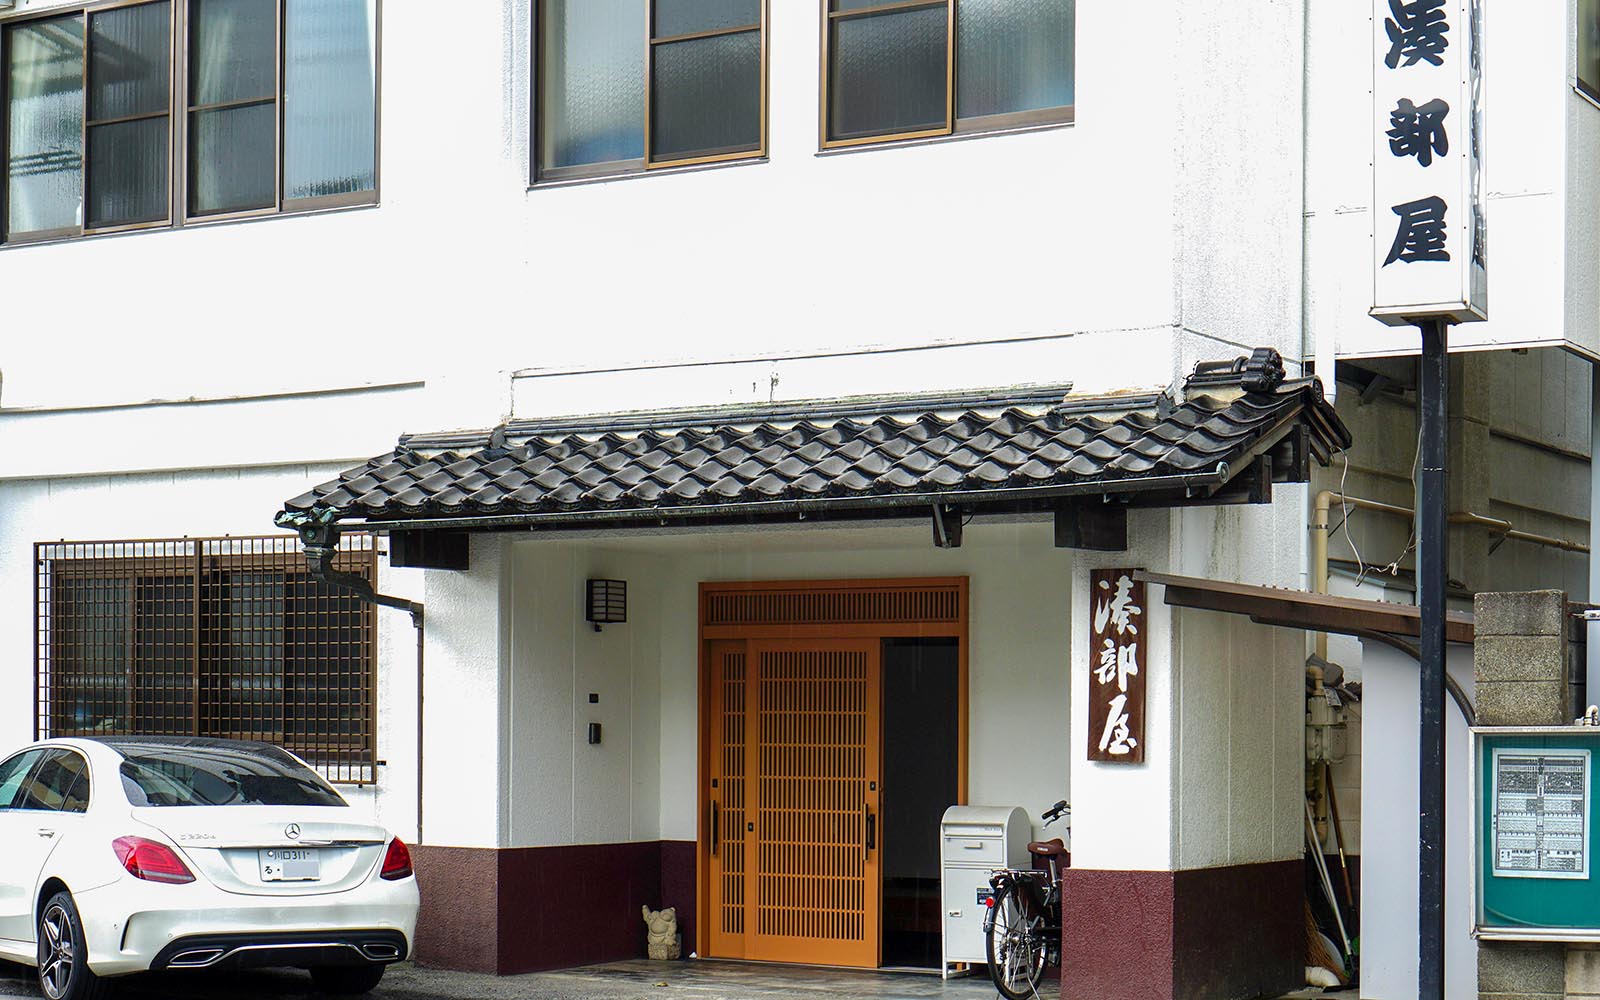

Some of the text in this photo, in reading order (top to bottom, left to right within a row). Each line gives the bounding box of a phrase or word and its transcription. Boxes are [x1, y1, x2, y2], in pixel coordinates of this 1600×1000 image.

[1381, 0, 1451, 268] 湊部屋
[1094, 575, 1142, 755] 湊部屋
